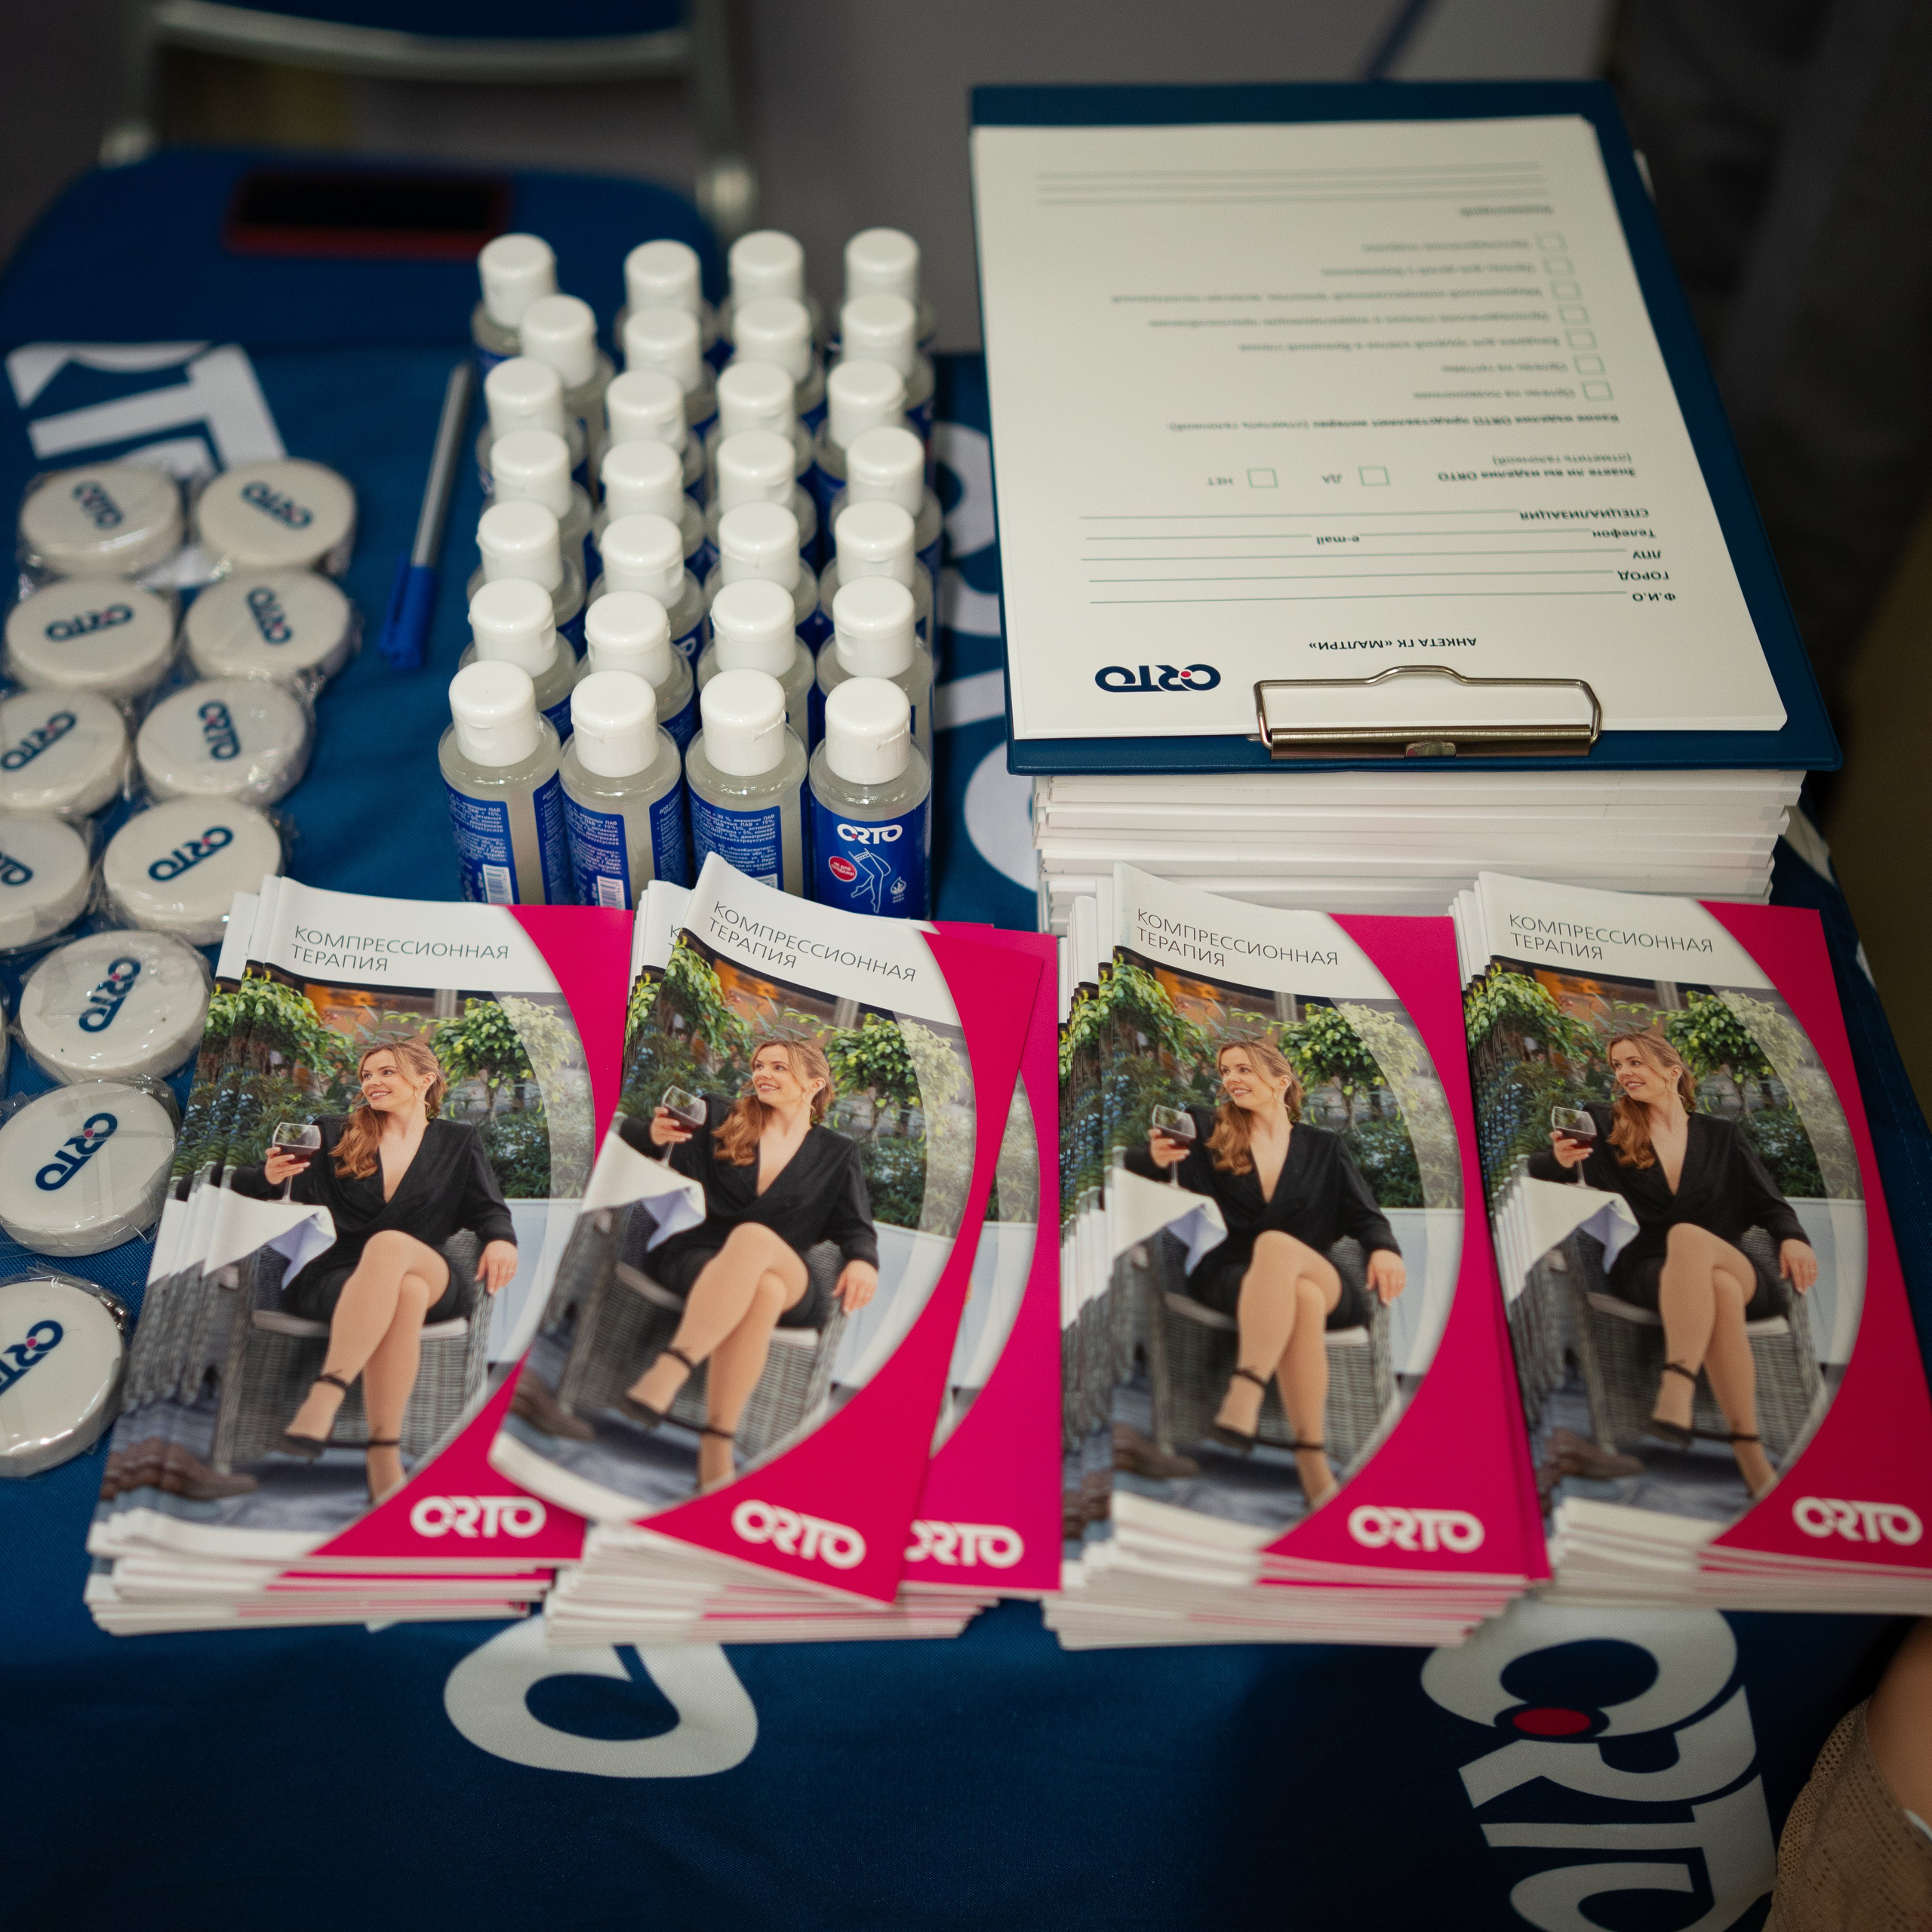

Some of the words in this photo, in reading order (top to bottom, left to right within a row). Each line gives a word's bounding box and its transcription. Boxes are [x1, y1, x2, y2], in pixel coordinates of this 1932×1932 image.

[1208, 477, 1233, 485] НЕТ
[1321, 474, 1342, 485] ДА
[1438, 471, 1478, 481] ORTO
[1481, 468, 1540, 480] изделия
[1567, 469, 1584, 478] ли
[1589, 467, 1635, 478] Знаете
[240, 480, 314, 529] ORTO
[1519, 507, 1649, 520] СПЕЦИАЛИЗАЦИЯ
[1316, 535, 1360, 545] e-mail
[1592, 528, 1656, 539] Телефон
[1632, 549, 1662, 560] ЛПУ
[1617, 570, 1669, 580] ГОРОД
[1632, 592, 1677, 602] Ф.И.О
[44, 603, 134, 642] ORTO
[245, 586, 294, 645] ORTO
[1309, 638, 1392, 651] «МАЛТРИ»
[1396, 638, 1415, 648] ГК
[1418, 637, 1477, 649] АНКЕТА
[1094, 663, 1221, 694] ORTO
[0, 710, 77, 771] ORTO
[198, 700, 241, 761] ORTO
[837, 823, 903, 844] ORTO
[148, 825, 234, 882] ORTO
[294, 924, 509, 960] КОМПРЕССИОННАЯ
[709, 916, 798, 969] ТЕРАПИЯ
[714, 900, 916, 982] КОМПРЕССИОННАЯ
[1137, 908, 1338, 965] КОМПРЕССИОННАЯ
[1137, 926, 1226, 967] ТЕРАПИЯ
[1509, 914, 1713, 953] КОМПРЕССИОННАЯ
[1510, 932, 1603, 960] ТЕРАПИЯ
[291, 943, 389, 972] ТЕРАПИЯ
[78, 955, 141, 1033] ORTO
[35, 1111, 118, 1192] ORTO
[0, 1319, 63, 1398] ORT
[410, 1494, 547, 1539] ORTO
[1347, 1505, 1485, 1555] ORTO
[1792, 1496, 1924, 1547] ORTO
[731, 1498, 867, 1571] ORTO
